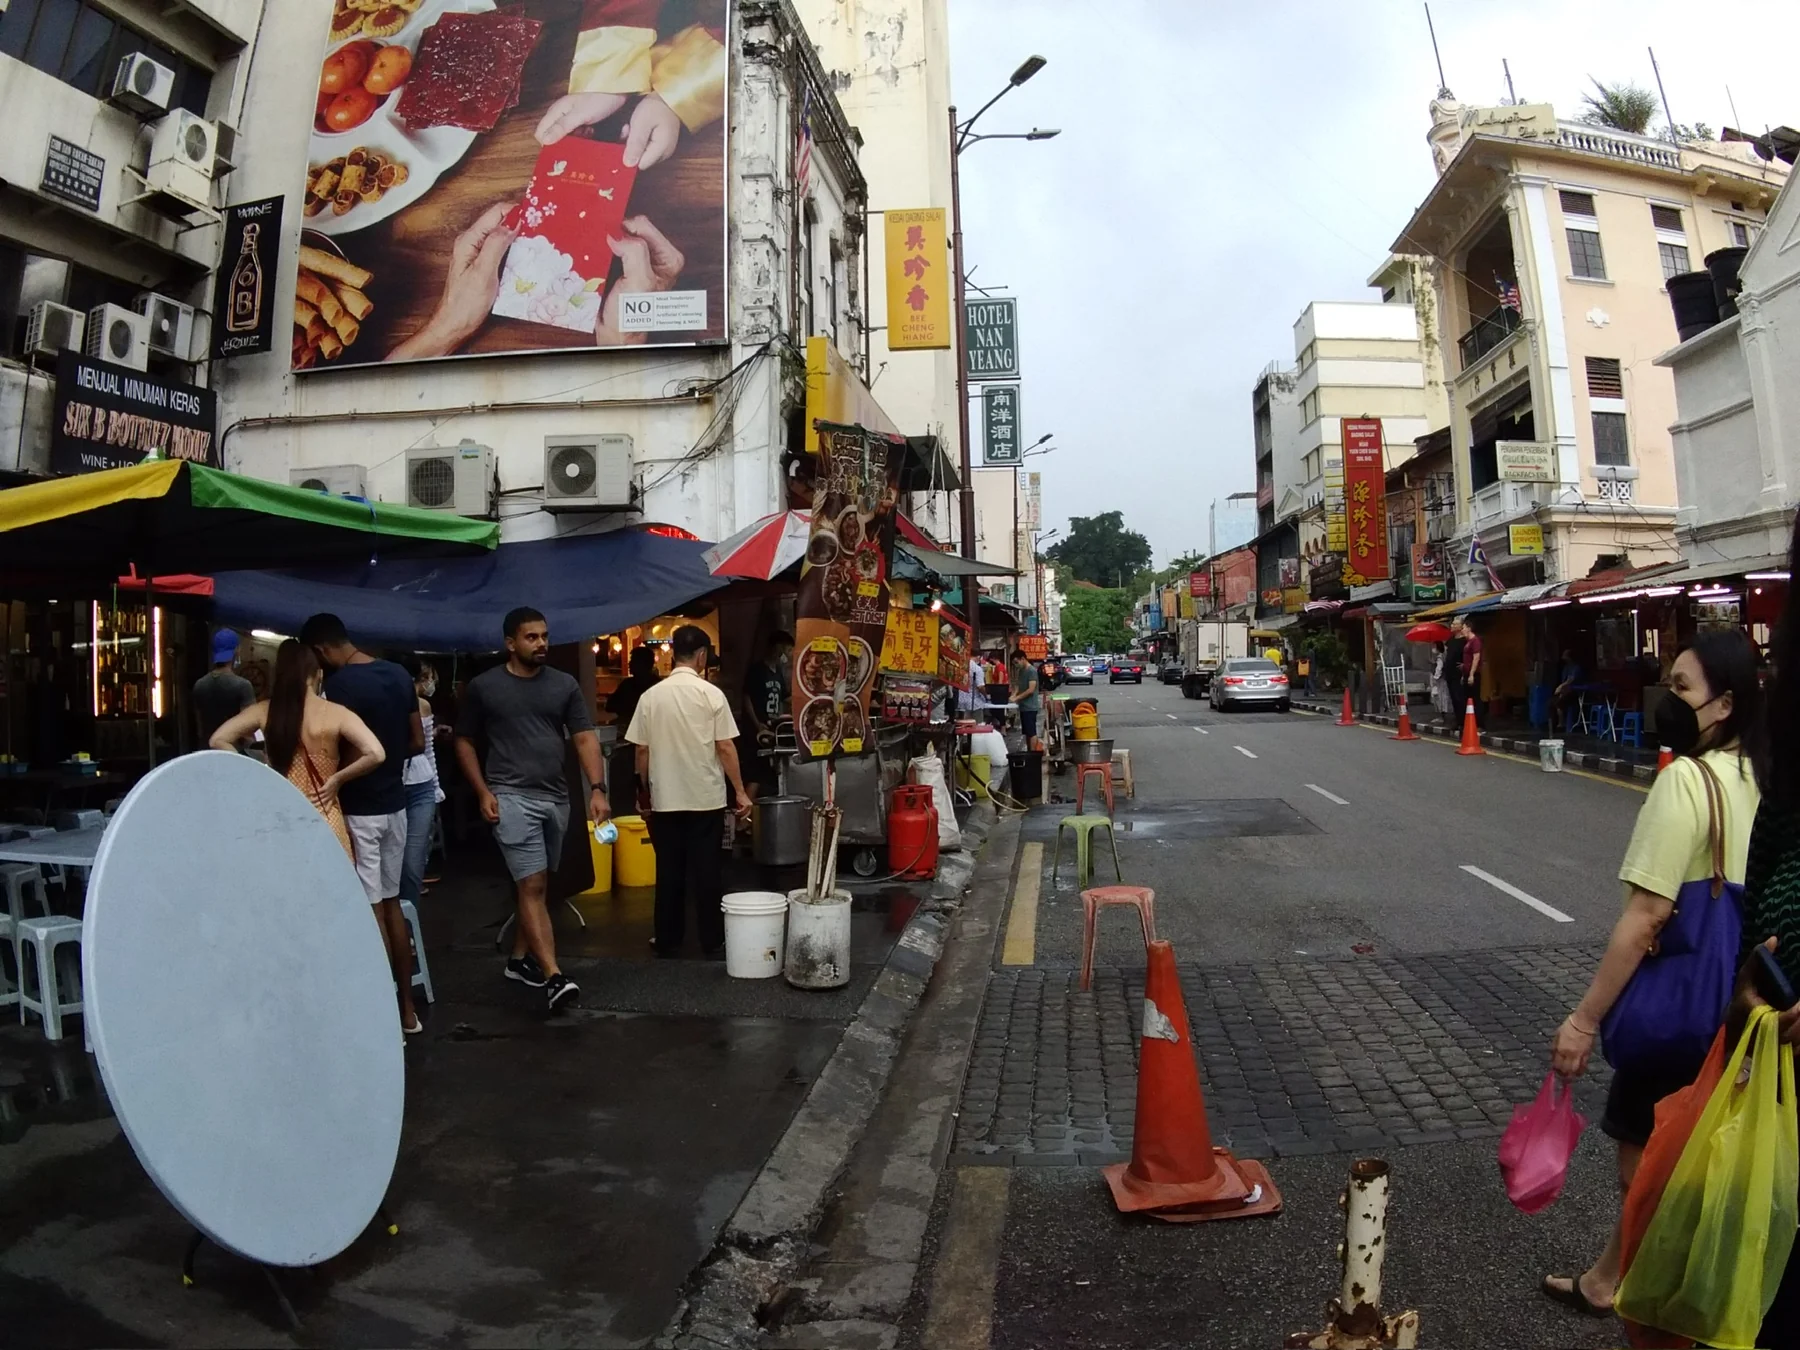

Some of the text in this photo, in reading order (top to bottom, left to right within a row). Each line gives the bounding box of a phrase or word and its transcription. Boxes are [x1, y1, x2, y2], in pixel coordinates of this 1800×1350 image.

[625, 300, 651, 314] NO
[968, 304, 1012, 326] HOTEL
[902, 324, 934, 332] CHENG
[902, 332, 934, 341] HIANG
[976, 328, 1004, 348] NAN
[969, 348, 1012, 370] YEANG
[78, 365, 200, 415] MENJUAL MINUMAN KERAS
[64, 400, 92, 440] SIX
[991, 391, 1013, 458] 南洋酒店
[80, 452, 108, 469] WINE
[1512, 528, 1540, 536] LAUNDRY
[864, 610, 886, 625] DISH
[896, 611, 926, 632] 特色
[885, 629, 932, 657] 葡萄牙
